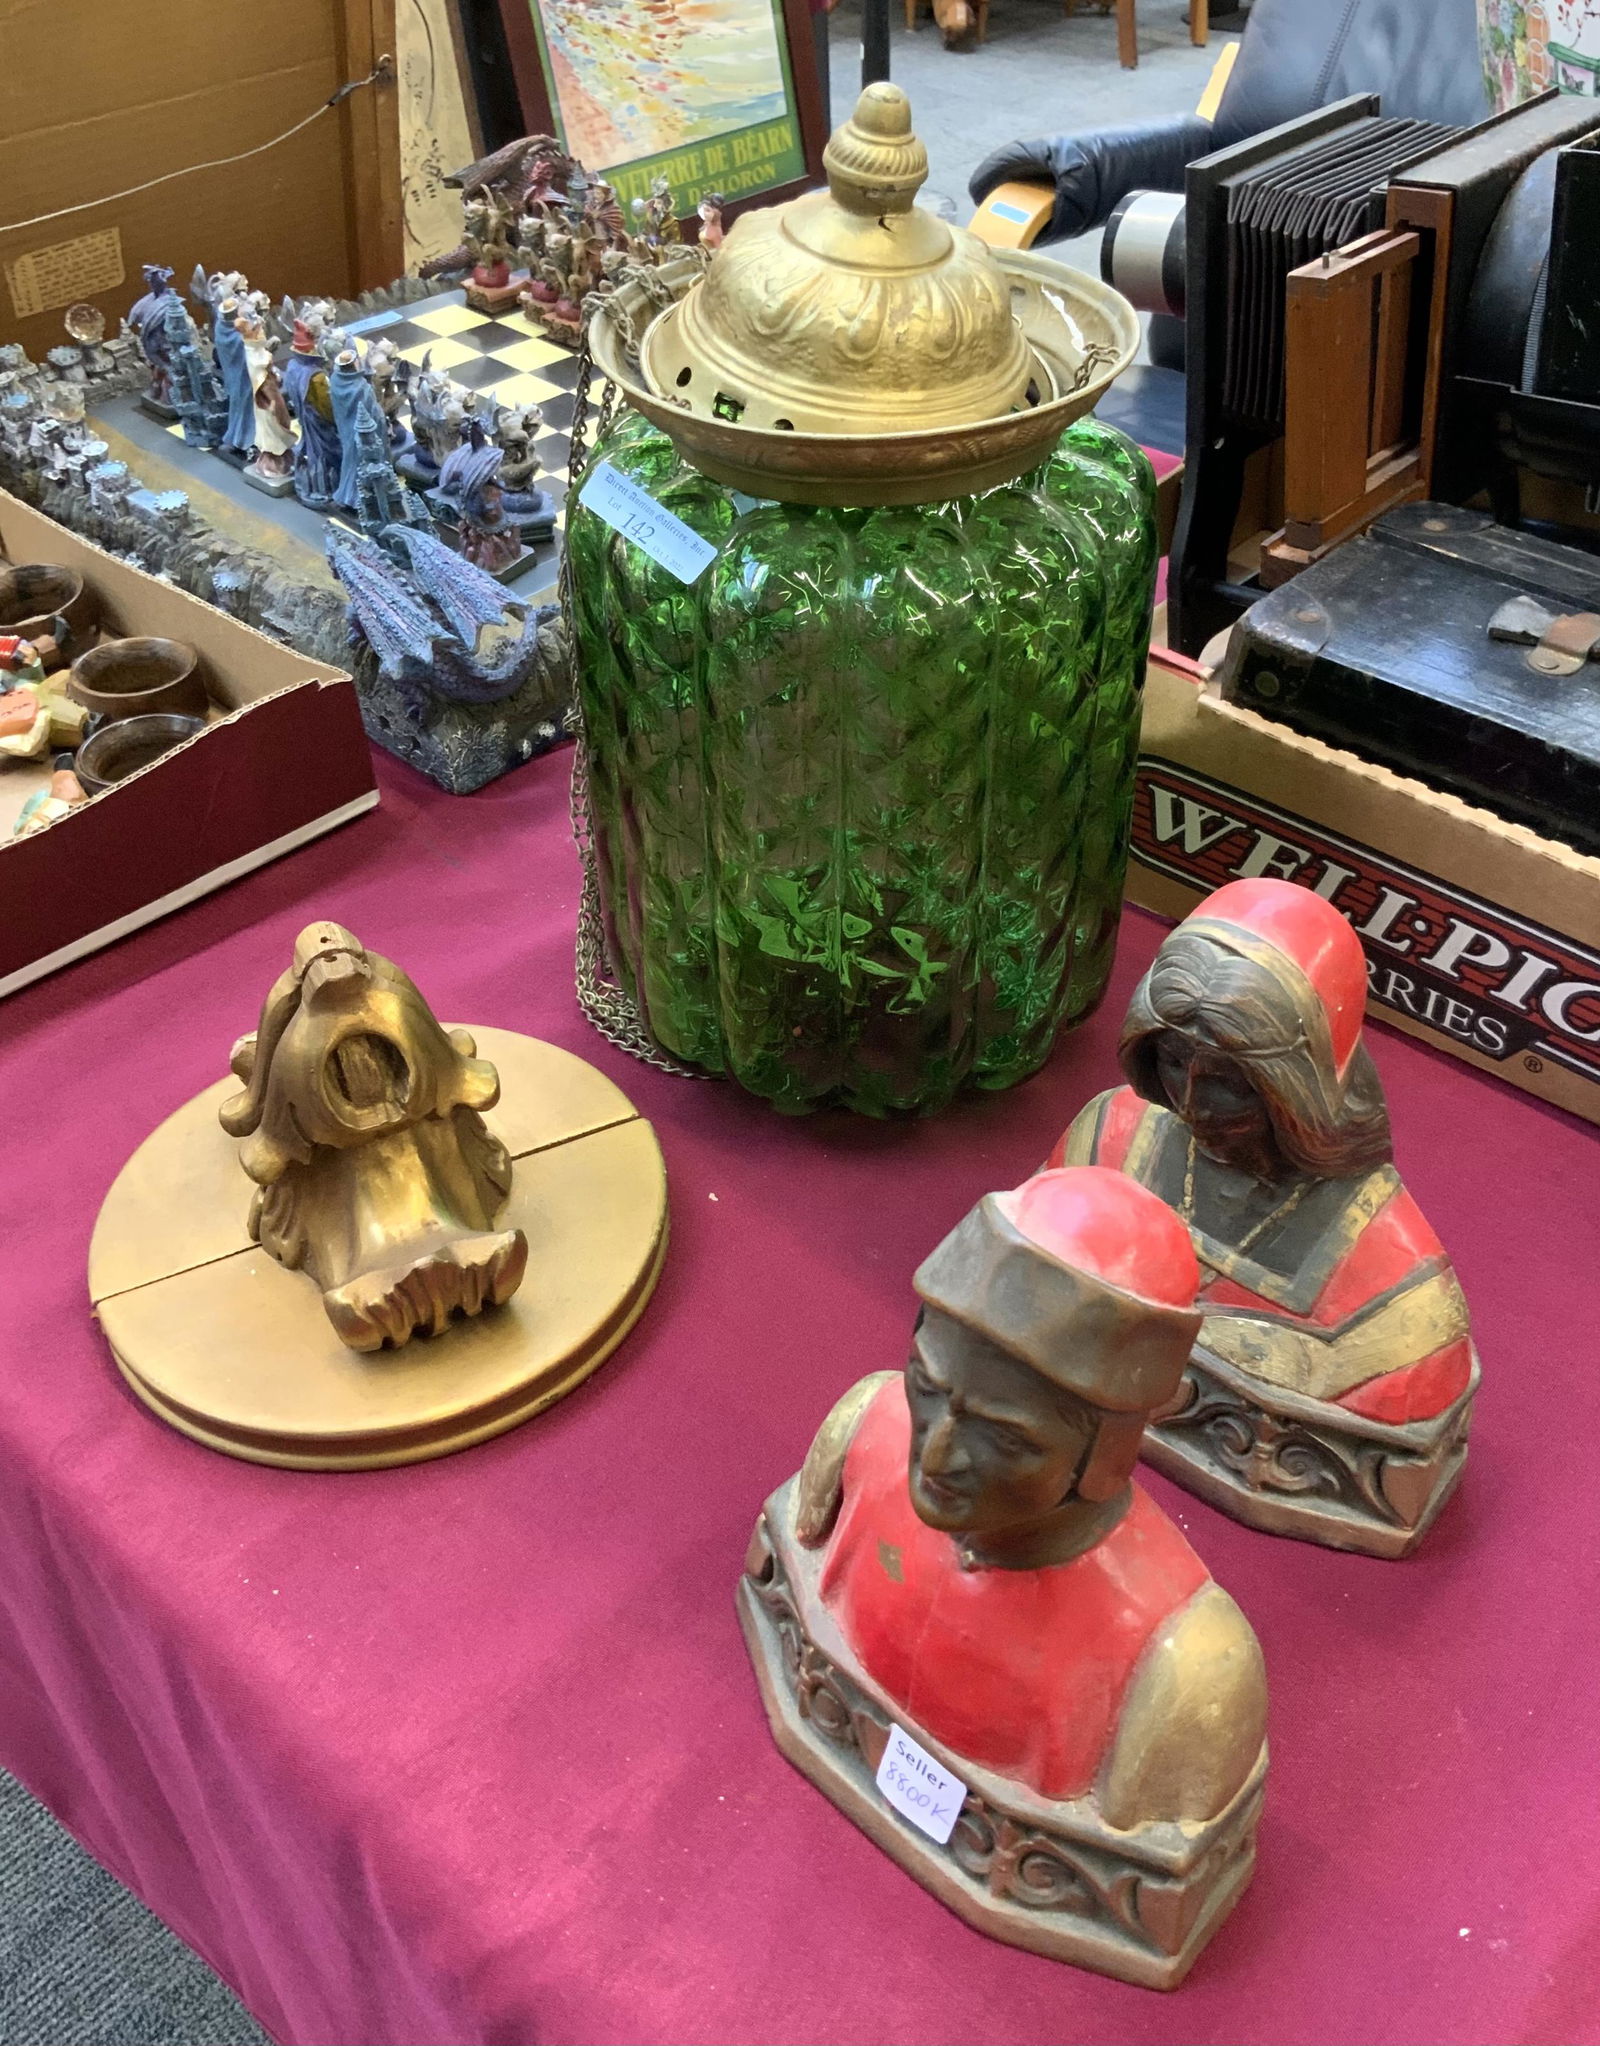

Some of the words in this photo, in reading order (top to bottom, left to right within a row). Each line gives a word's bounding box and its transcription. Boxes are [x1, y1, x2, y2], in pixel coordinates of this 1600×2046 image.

[704, 144, 730, 175] DE
[605, 472, 628, 496] Direct
[628, 491, 656, 517] Auction
[655, 514, 689, 545] Galleries,
[607, 496, 622, 511] Lot
[620, 512, 655, 546] 142
[895, 1740, 948, 1790] Seller
